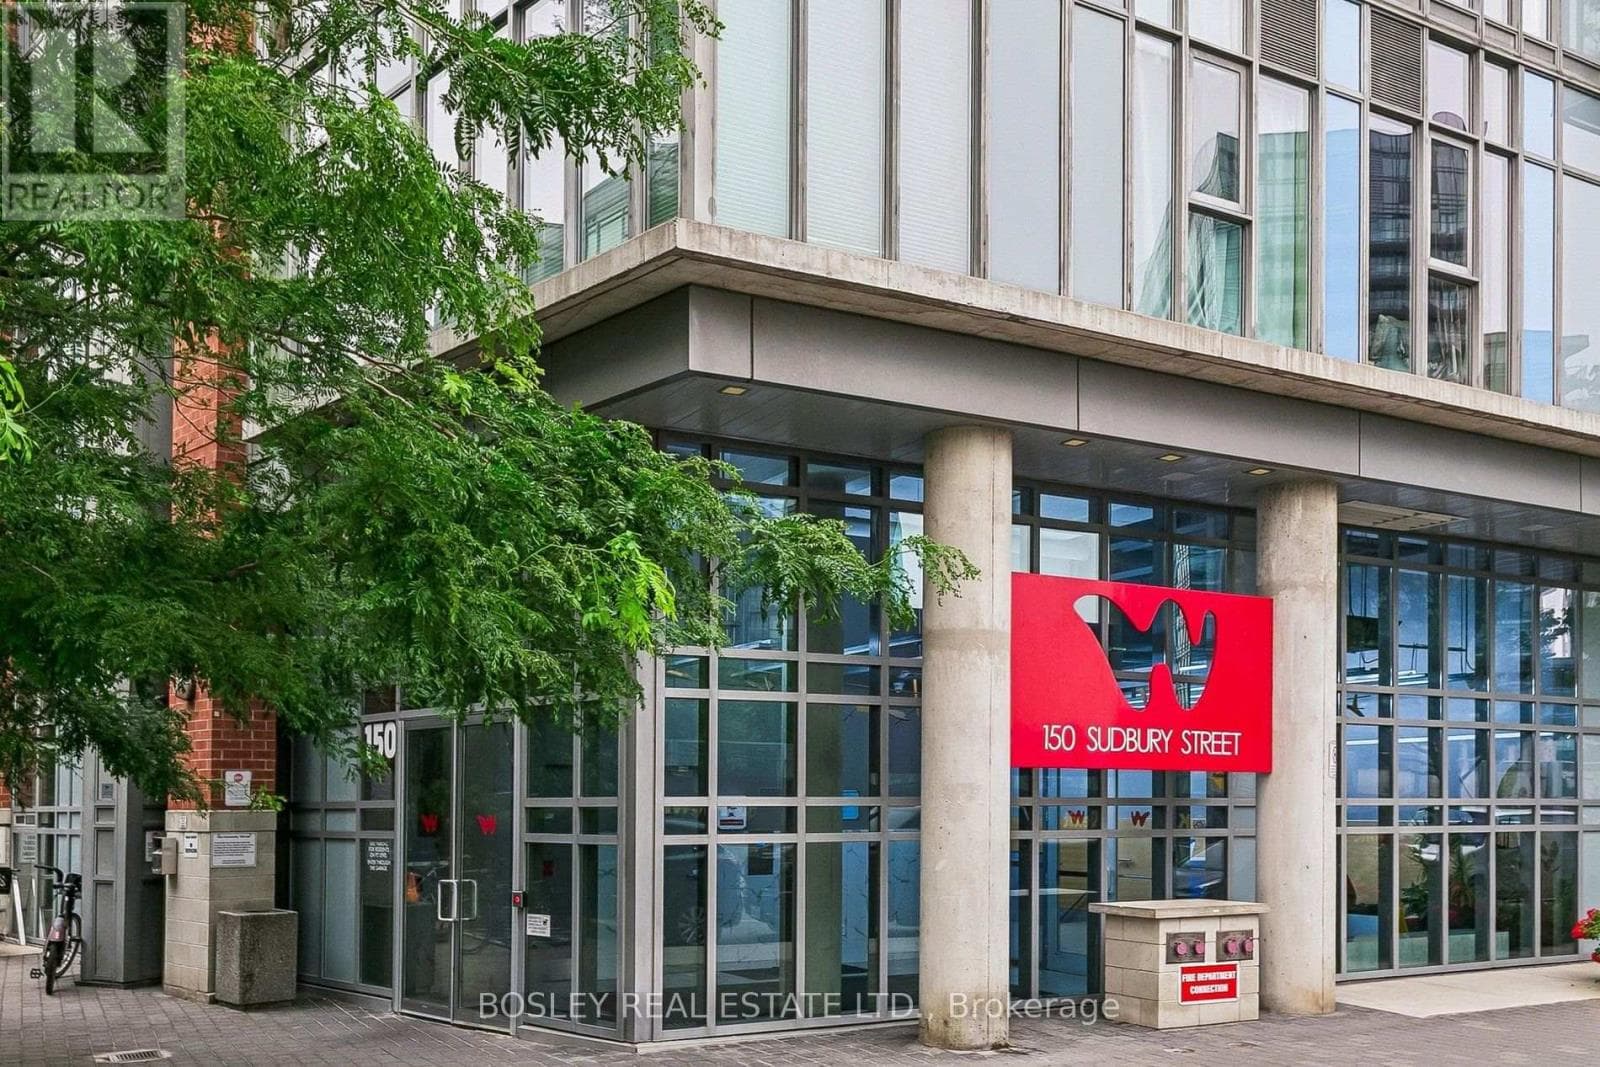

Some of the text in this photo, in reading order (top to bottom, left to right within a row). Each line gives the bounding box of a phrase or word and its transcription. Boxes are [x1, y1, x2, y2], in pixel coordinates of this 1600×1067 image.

[365, 722, 396, 758] 150
[1043, 724, 1242, 756] 150 SUDBURY STREET
[1182, 971, 1236, 982] FIRE DEPARTMENT
